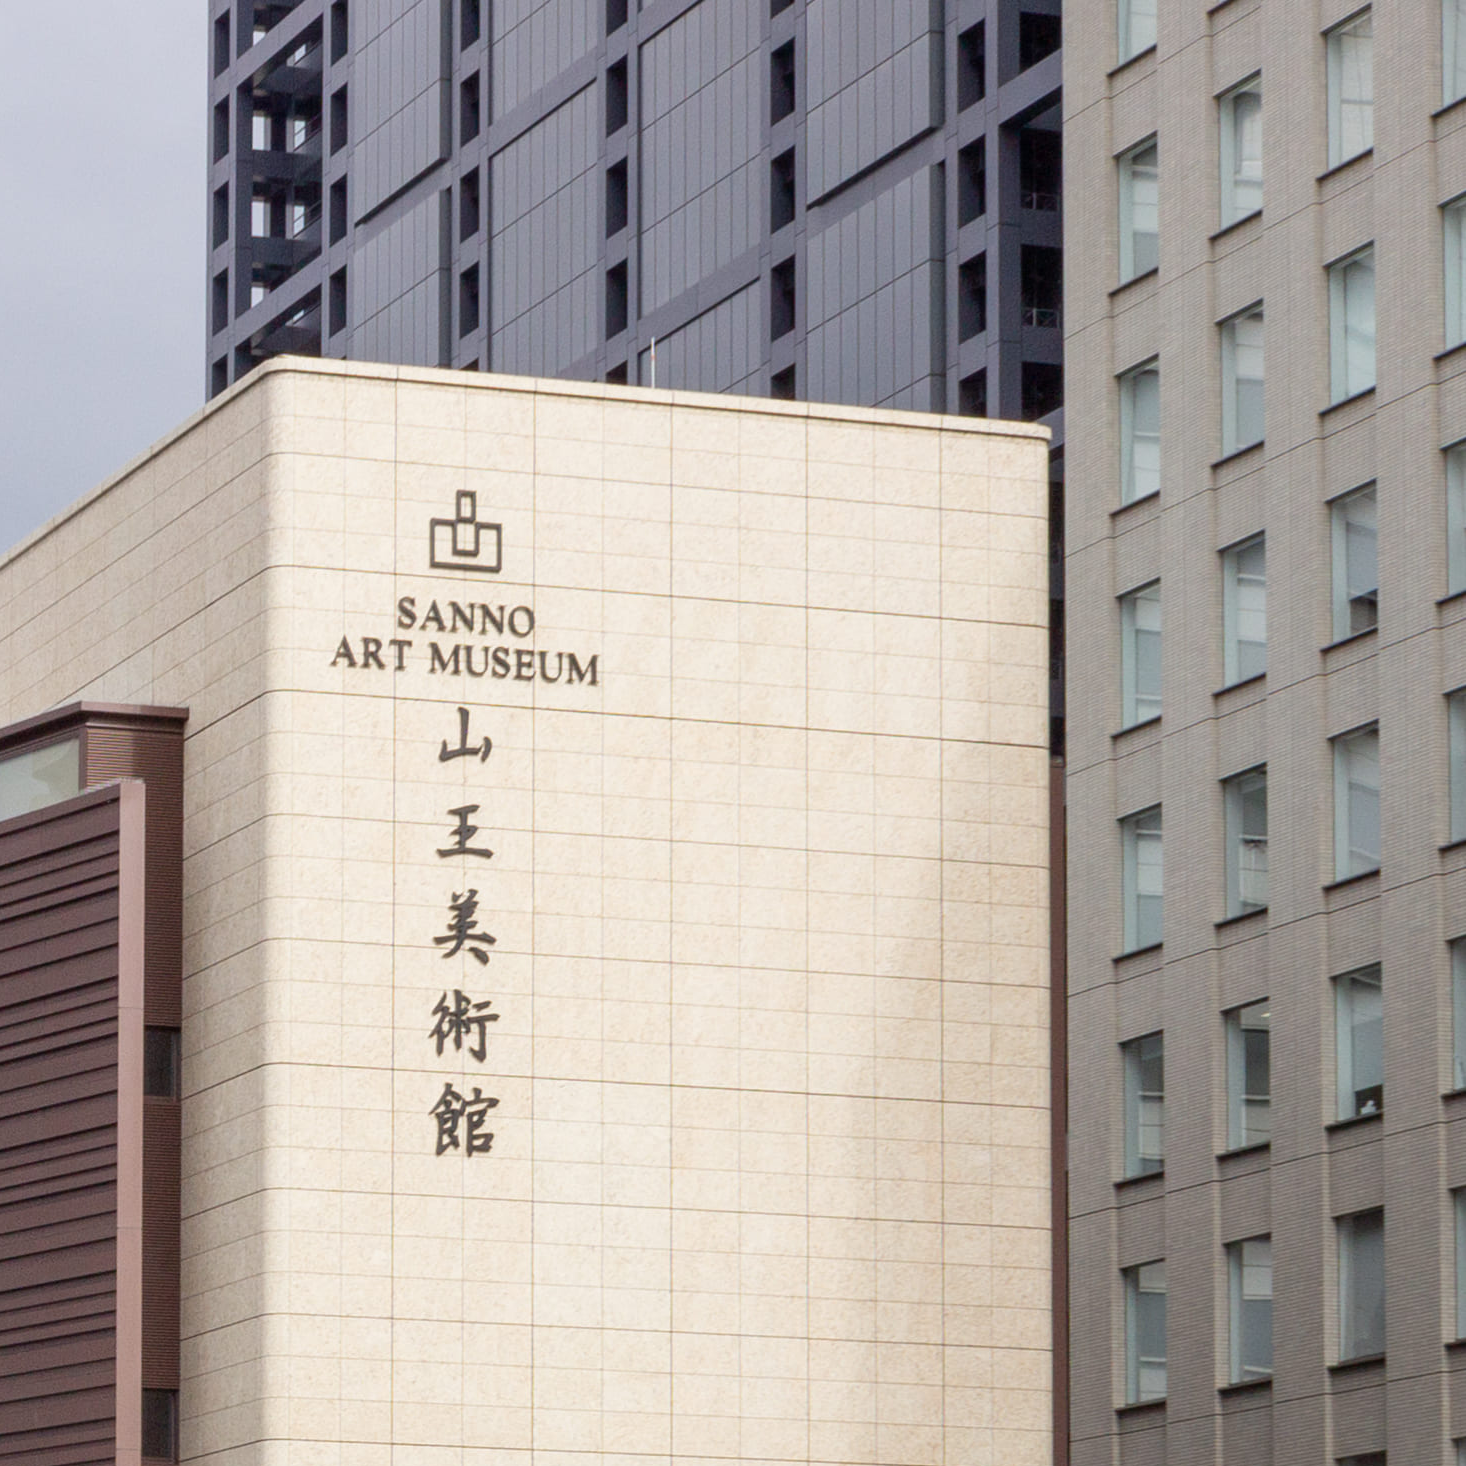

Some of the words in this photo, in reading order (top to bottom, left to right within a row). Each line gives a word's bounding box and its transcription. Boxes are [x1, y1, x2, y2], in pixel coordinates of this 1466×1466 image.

[397, 596, 535, 638] SANNO
[330, 634, 412, 671] ART
[427, 641, 600, 686] MUSEUM
[428, 706, 500, 1158] 山王美術館
